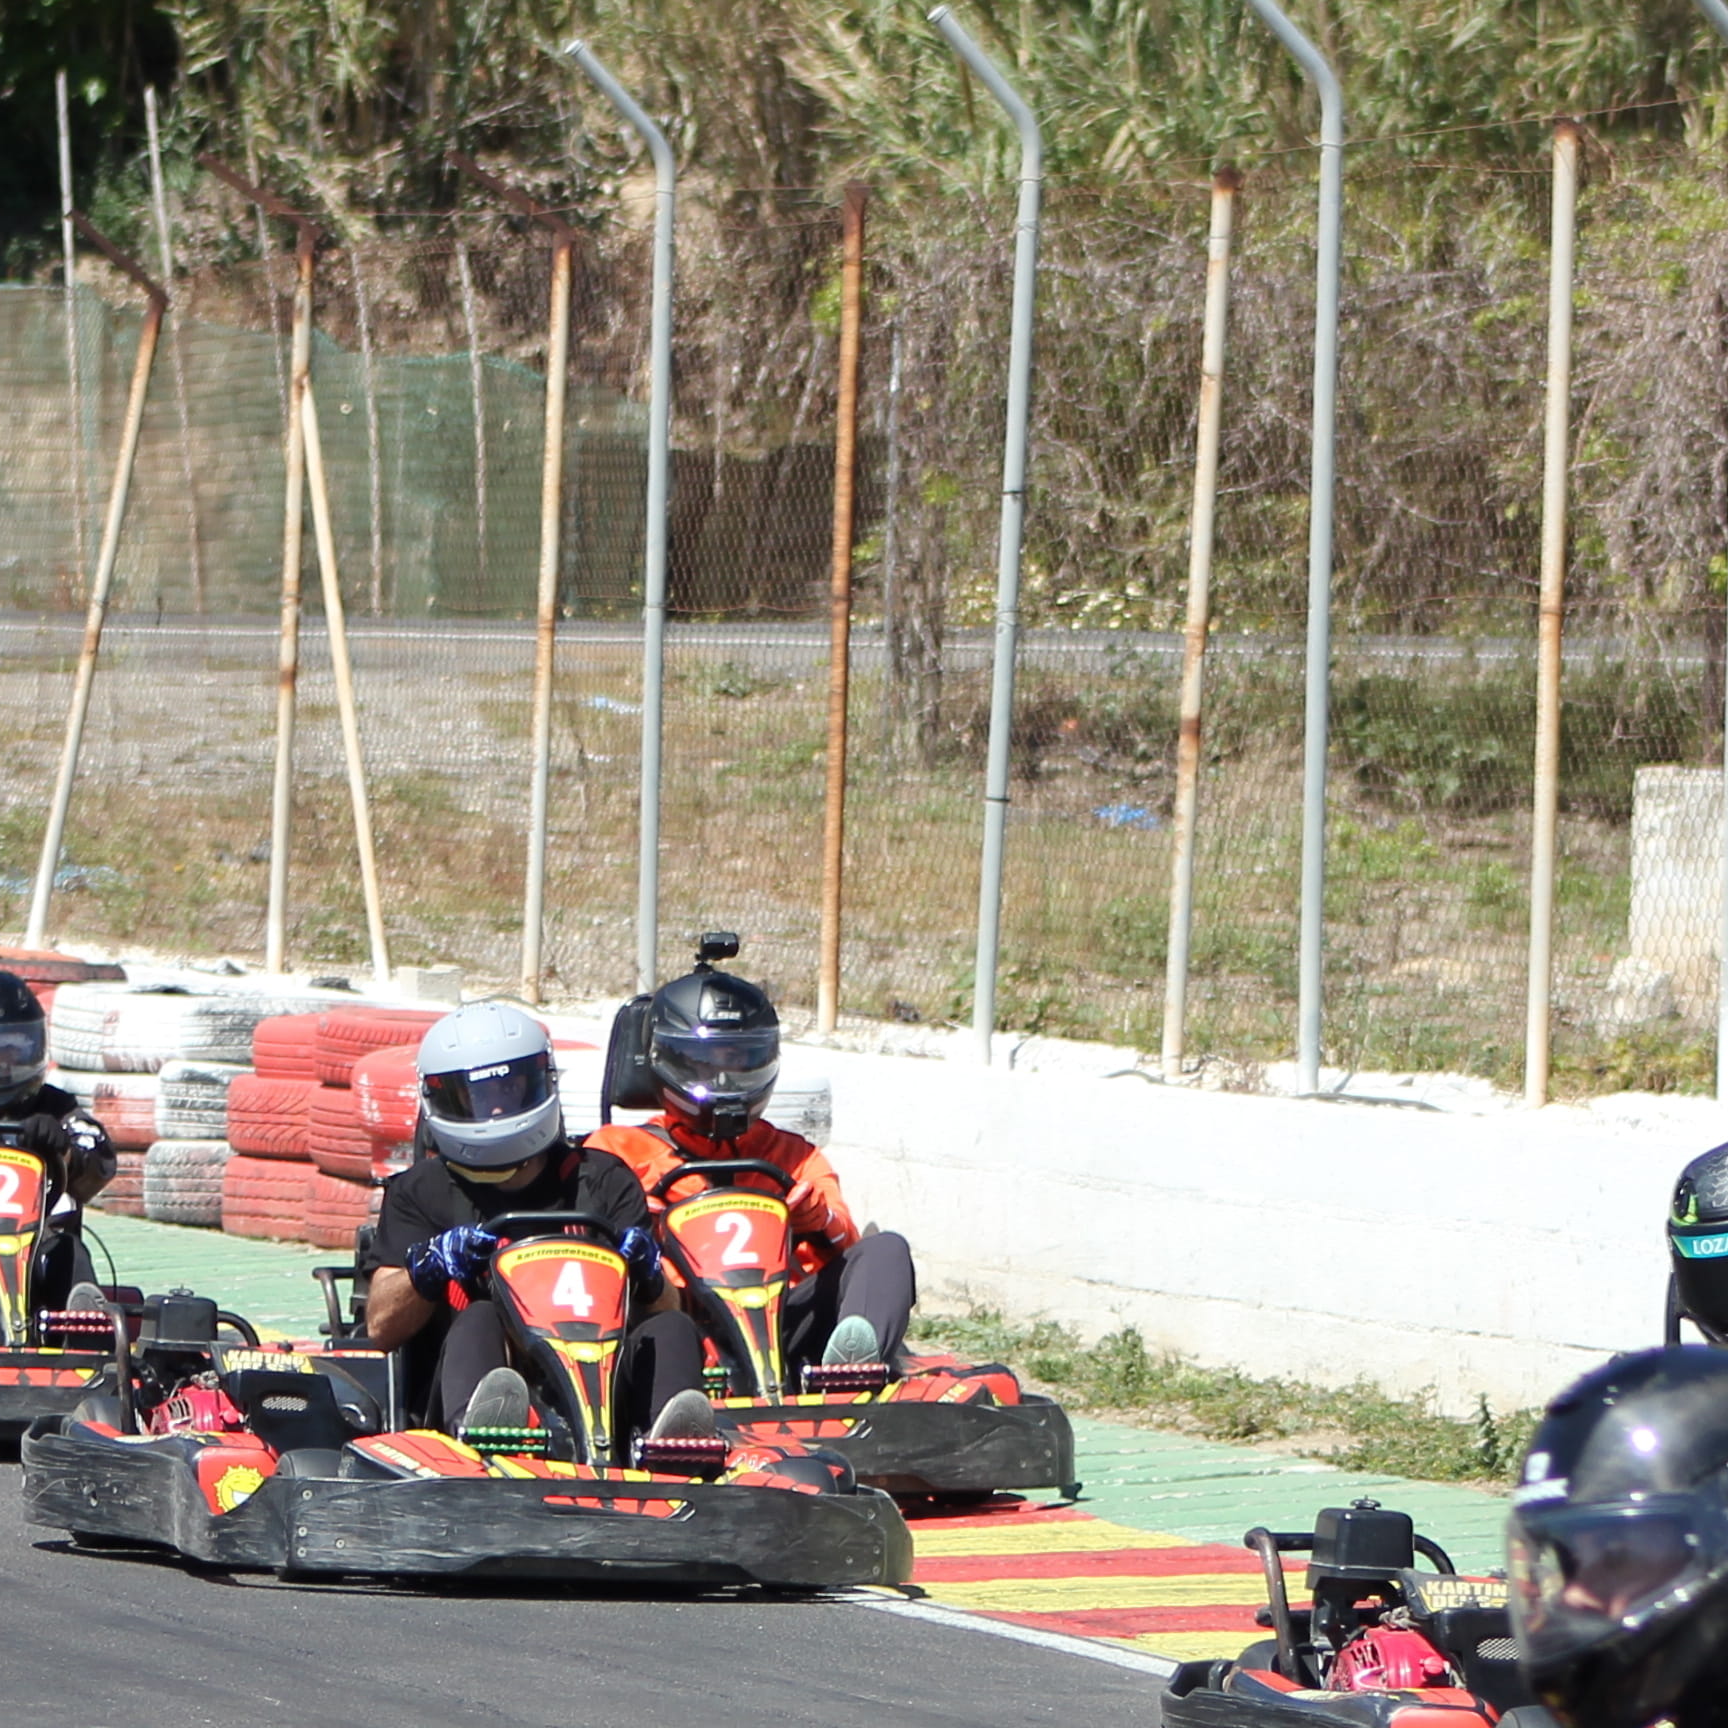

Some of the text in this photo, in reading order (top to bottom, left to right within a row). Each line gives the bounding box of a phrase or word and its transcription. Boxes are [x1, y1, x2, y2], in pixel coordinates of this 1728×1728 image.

[715, 1211, 759, 1267] 2
[552, 1260, 594, 1317] 4
[1425, 1580, 1508, 1597] KARTIN
